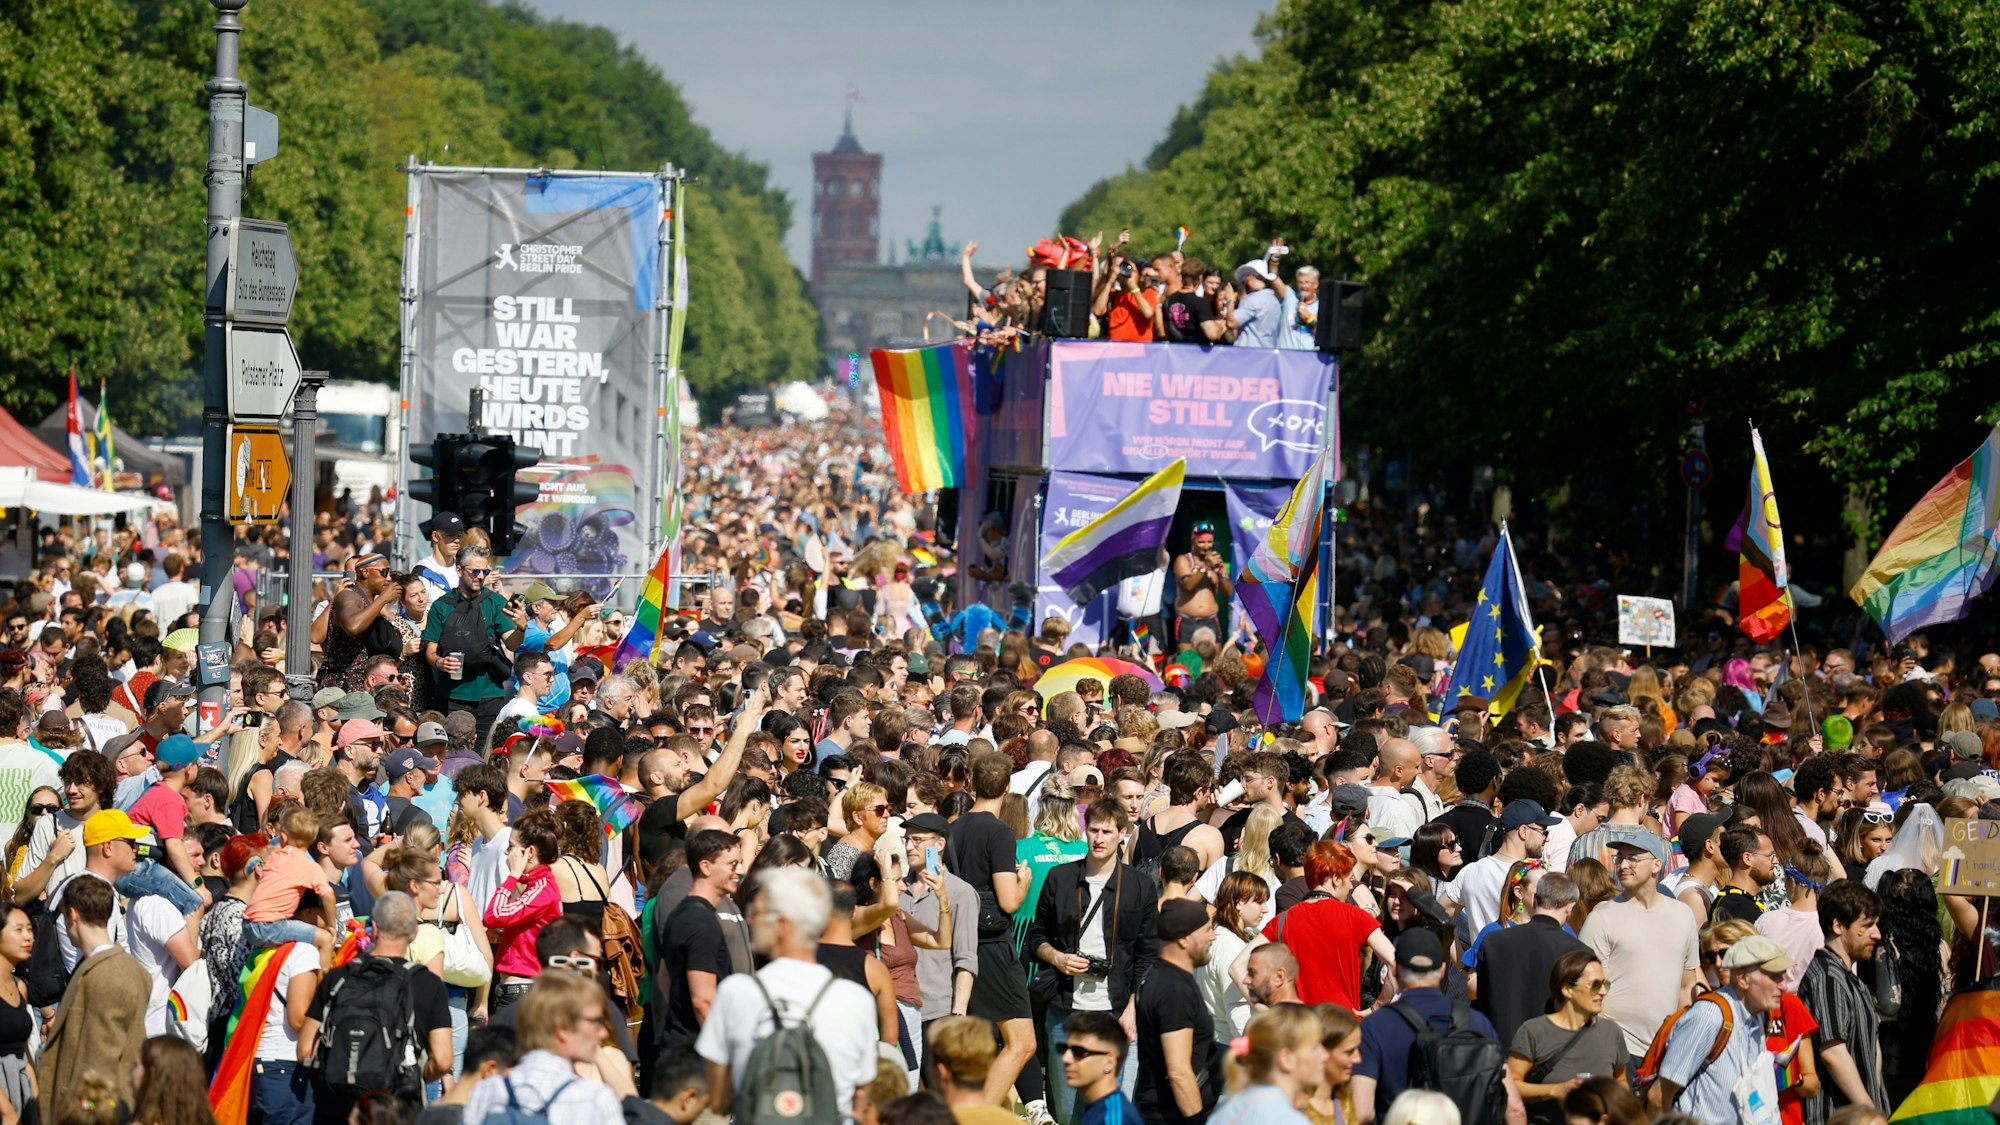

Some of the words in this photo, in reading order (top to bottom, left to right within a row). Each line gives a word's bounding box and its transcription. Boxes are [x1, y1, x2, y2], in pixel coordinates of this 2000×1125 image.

[251, 241, 275, 276] Reichstag
[520, 244, 583, 255] CHRISTOPHER
[520, 253, 555, 263] STREET
[556, 254, 576, 264] DAY
[520, 263, 553, 272] BERLIN
[555, 264, 583, 274] PRIDE
[249, 278, 257, 300] des
[258, 279, 286, 307] Bundestages
[493, 295, 580, 323] STILL
[495, 322, 577, 350] WAR
[242, 359, 268, 386] Potsdamer
[269, 361, 284, 387] Platz
[452, 347, 609, 384] GESTERN,
[479, 375, 581, 403] HEUTE
[1103, 372, 1152, 397] NIE
[1160, 374, 1280, 402] WIEDER
[481, 402, 590, 430] WIRDS
[1149, 400, 1233, 427] STILL
[1191, 438, 1223, 448] NICHT
[539, 482, 564, 492] ICHT
[566, 482, 588, 494] AUF,
[552, 494, 597, 504] WERDEN!
[1953, 821, 2000, 841] GEND
